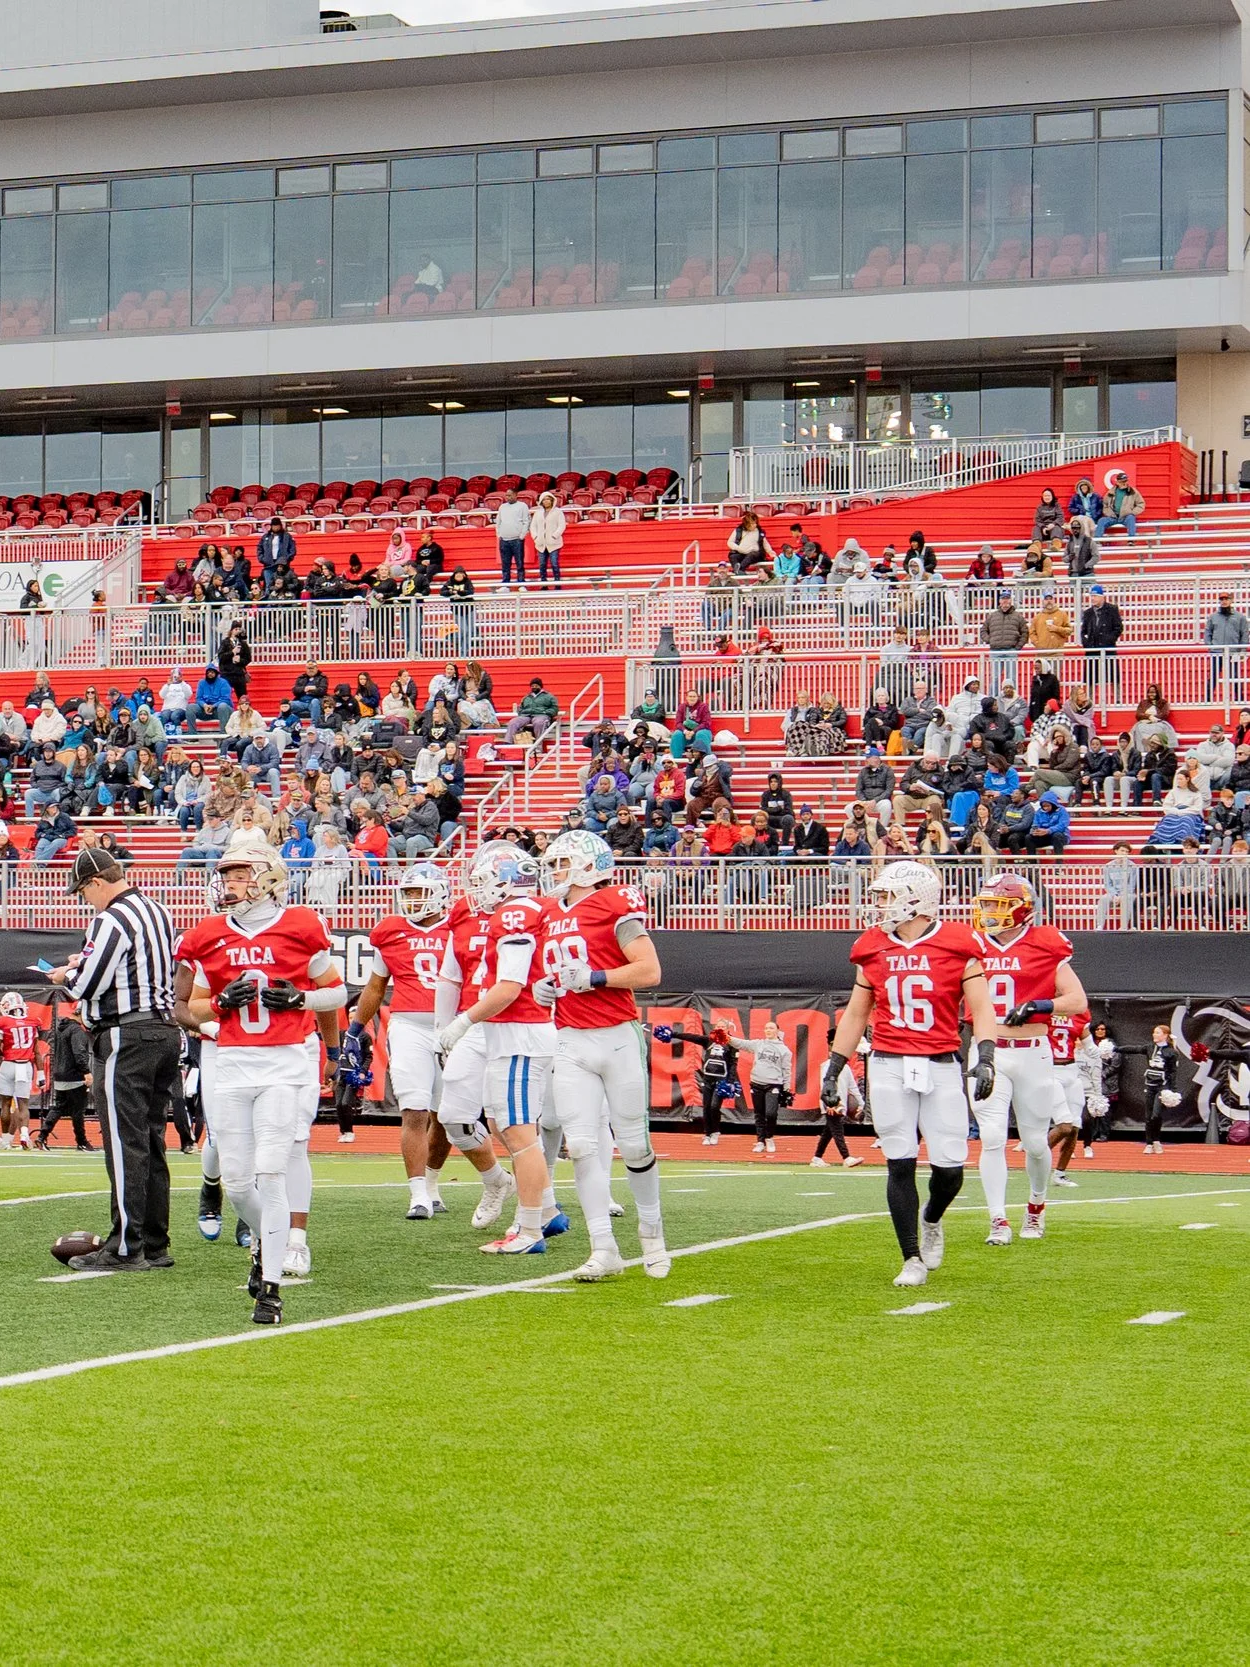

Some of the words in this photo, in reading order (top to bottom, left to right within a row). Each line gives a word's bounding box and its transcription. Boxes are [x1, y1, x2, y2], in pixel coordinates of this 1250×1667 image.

[502, 911, 526, 931] 92
[548, 917, 579, 936] TACA
[407, 937, 443, 951] TACA
[226, 946, 276, 966] TACA
[886, 955, 931, 972] TACA
[984, 957, 1021, 971] TACA
[239, 969, 270, 1034] 0
[885, 975, 935, 1032] 16
[9, 1026, 34, 1050] 10
[1052, 1028, 1071, 1059] 3
